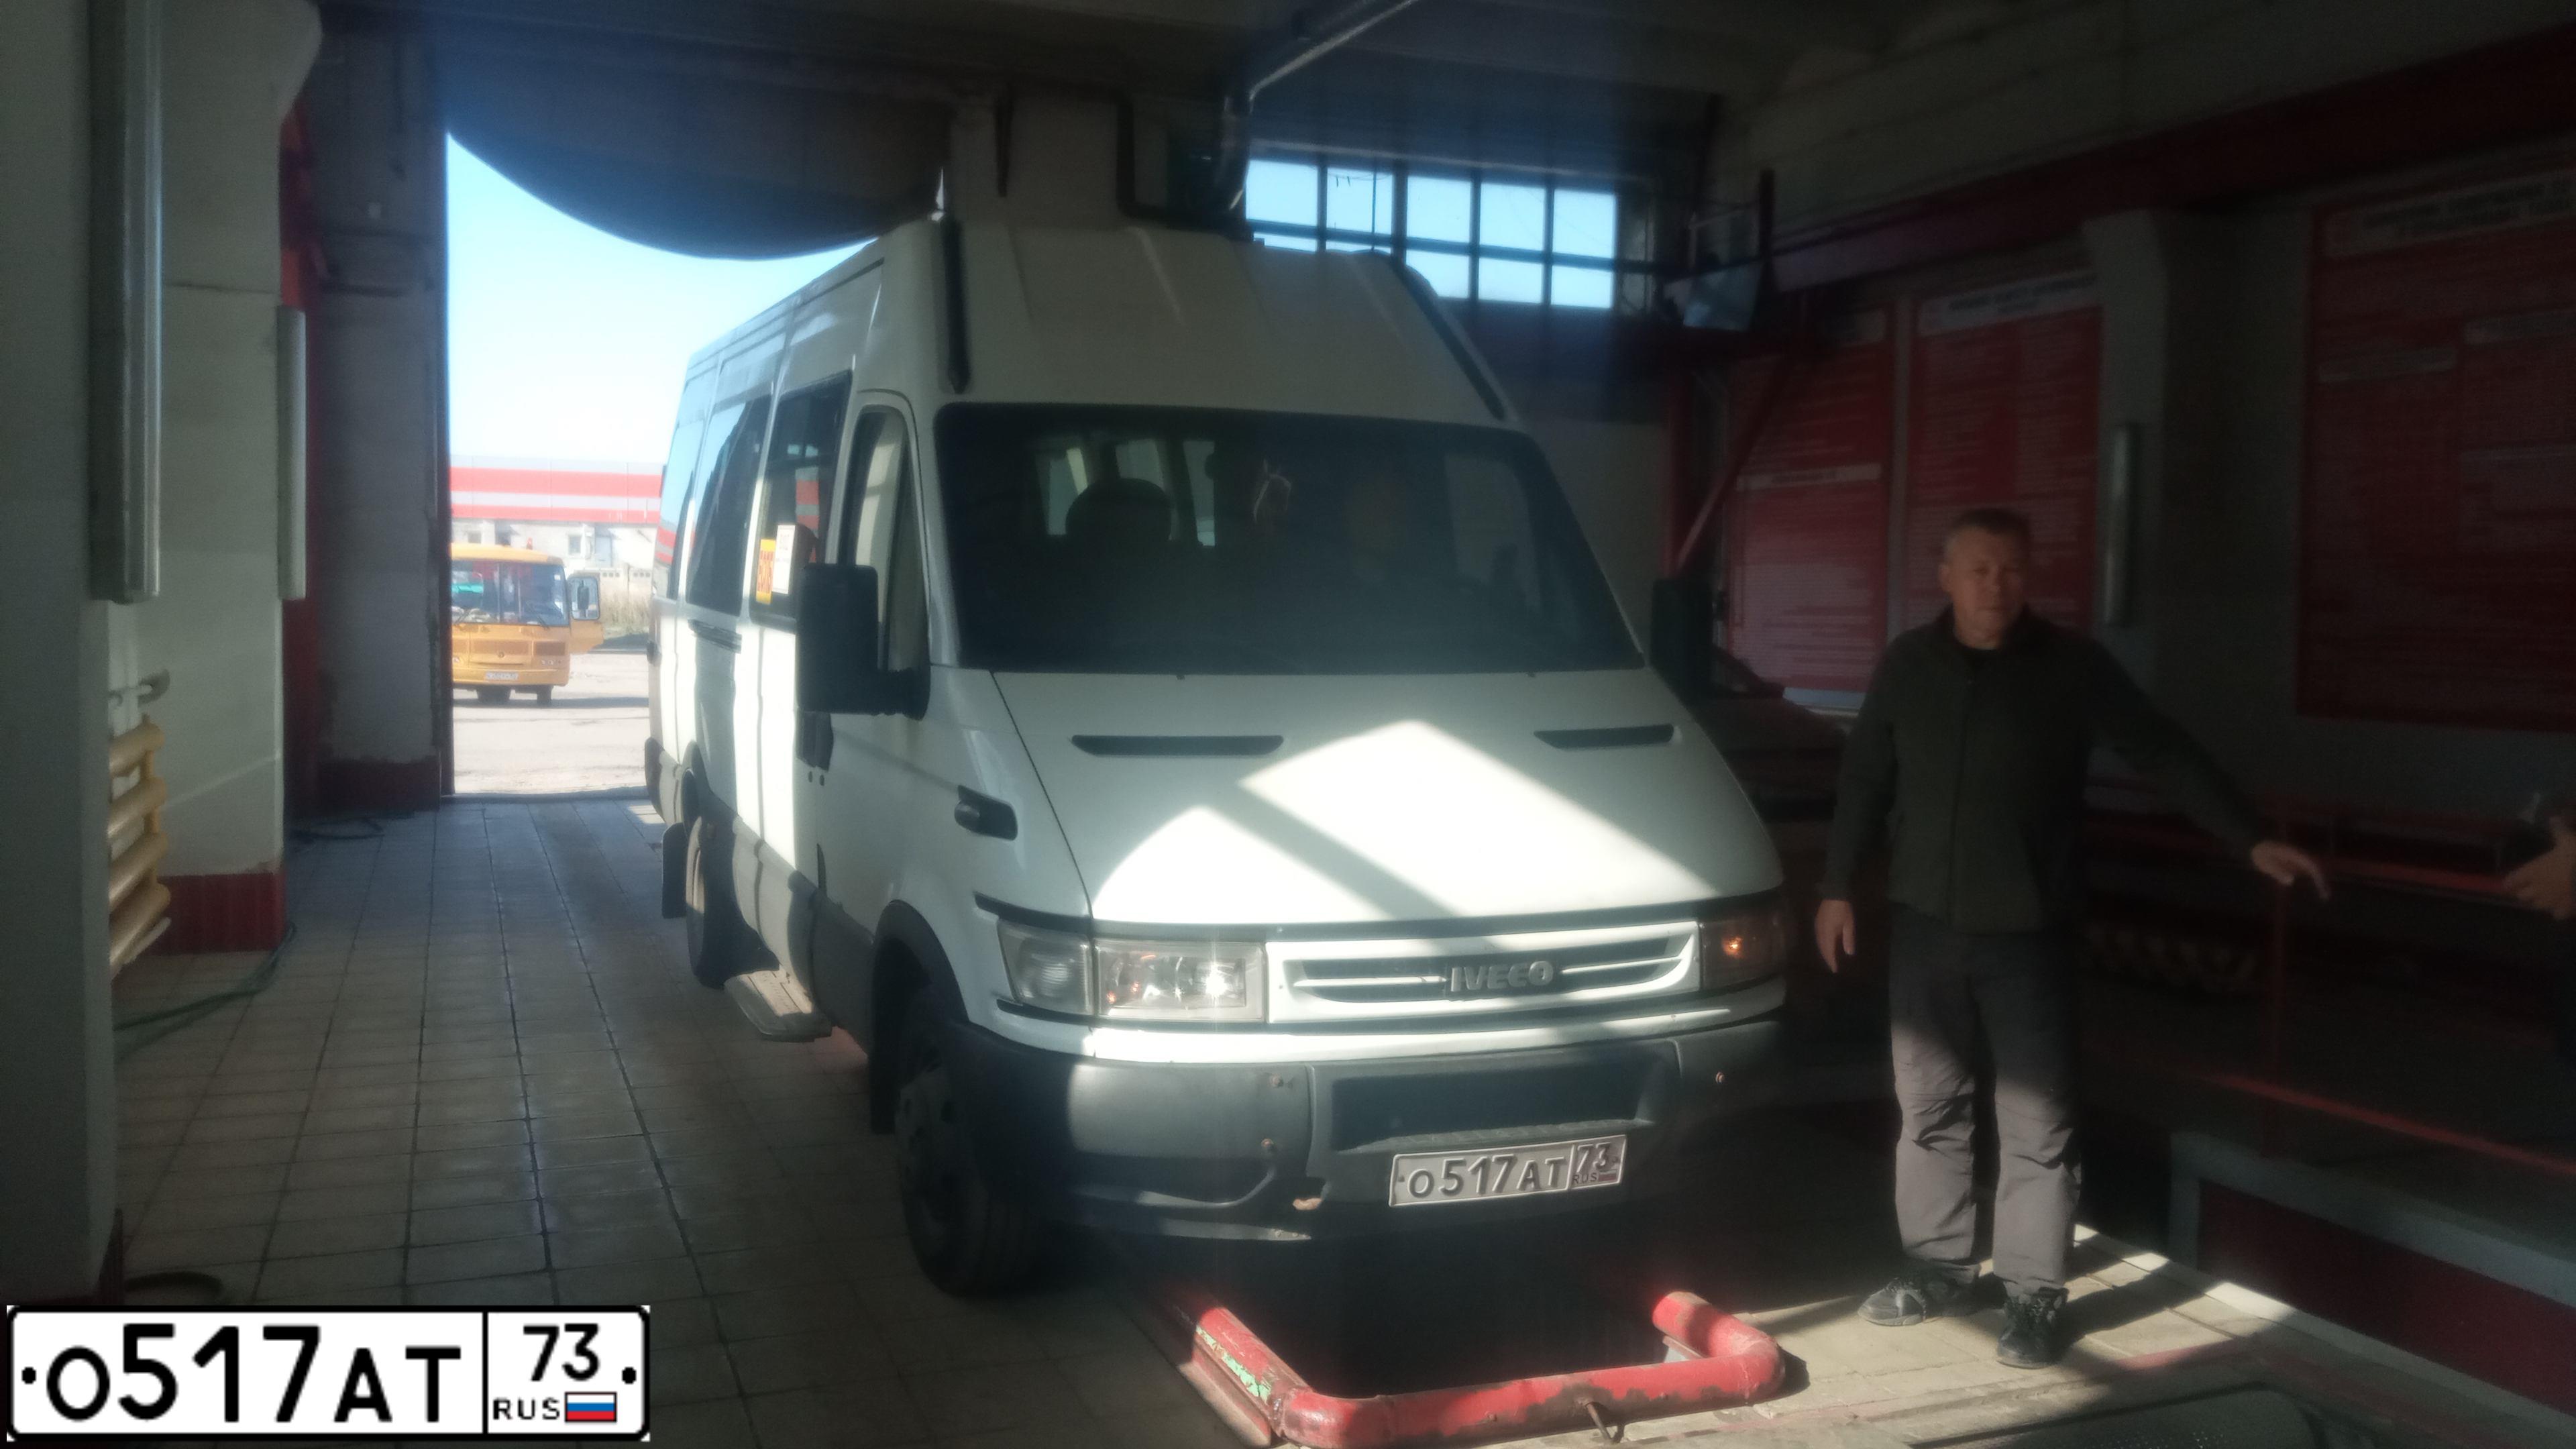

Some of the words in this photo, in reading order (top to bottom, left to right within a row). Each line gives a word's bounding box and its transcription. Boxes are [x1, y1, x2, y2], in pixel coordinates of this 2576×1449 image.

[1450, 960, 1554, 992] IVECO
[1408, 1153, 1565, 1198] О517АТ
[1576, 1142, 1611, 1174] 73
[1572, 1173, 1597, 1185] RUS
